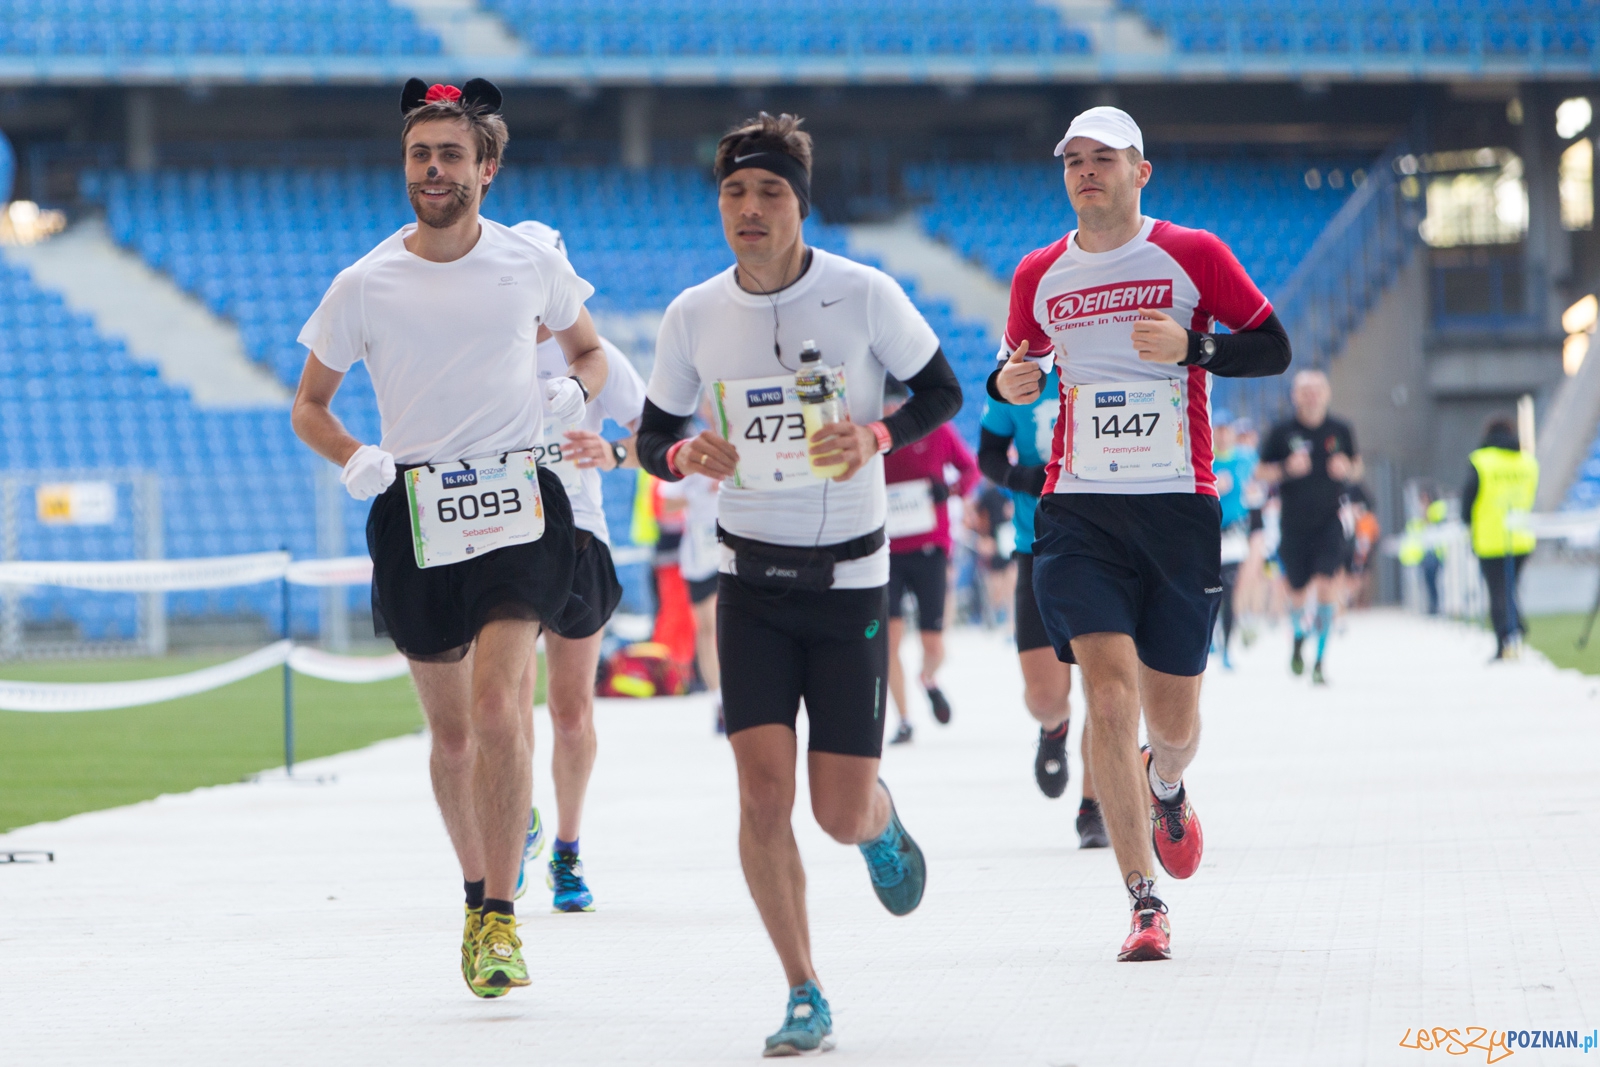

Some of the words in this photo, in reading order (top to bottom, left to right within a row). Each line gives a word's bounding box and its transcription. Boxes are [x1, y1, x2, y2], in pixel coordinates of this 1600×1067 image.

[1082, 285, 1170, 314] ENERVIT
[1054, 320, 1095, 333] Science
[1098, 317, 1109, 325] in
[762, 390, 782, 402] PKO
[1097, 396, 1108, 404] 16.
[1108, 394, 1124, 403] PKO
[1092, 412, 1160, 439] 1447
[776, 451, 805, 460] Patryk
[1103, 445, 1151, 455] Przemysław
[444, 475, 457, 485] 16.
[457, 473, 475, 484] PKO
[480, 471, 507, 481] maraton
[437, 488, 522, 523] 6093
[462, 525, 504, 537] Sebastian
